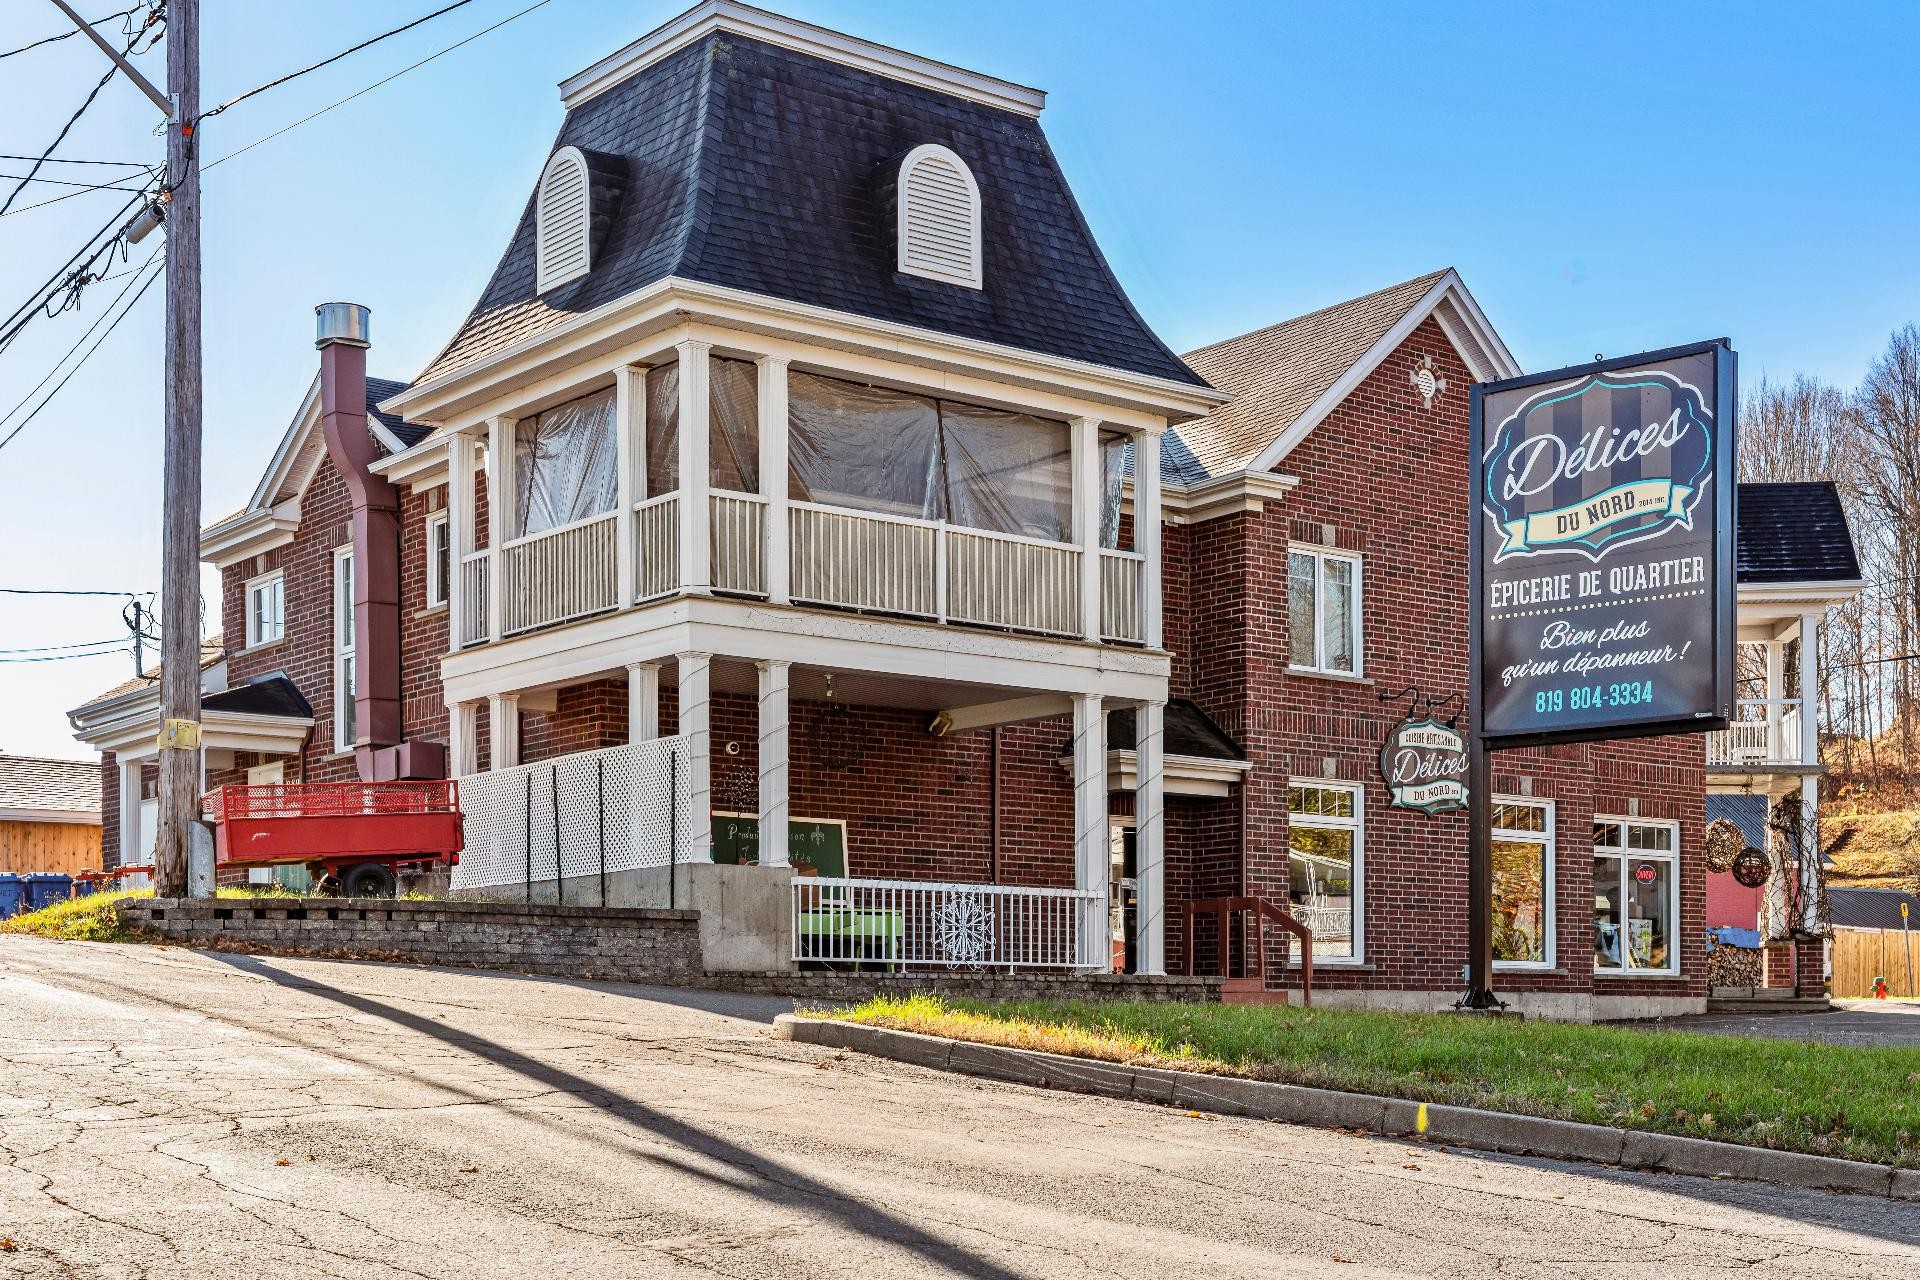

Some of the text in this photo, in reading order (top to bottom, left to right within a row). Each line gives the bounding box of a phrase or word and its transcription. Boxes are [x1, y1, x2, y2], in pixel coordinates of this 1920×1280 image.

[1503, 407, 1690, 501] Délices
[1557, 512, 1580, 535] DU
[1585, 490, 1635, 526] NORD
[1490, 556, 1705, 608] ÉPICERIE DE QUARTIER
[1540, 619, 1651, 650] Bien plus
[1501, 658, 1559, 688] qu'un
[1535, 680, 1653, 713] 819 804-3334
[1392, 749, 1470, 783] Délices
[1413, 790, 1425, 801] DU
[1428, 784, 1450, 799] NORD
